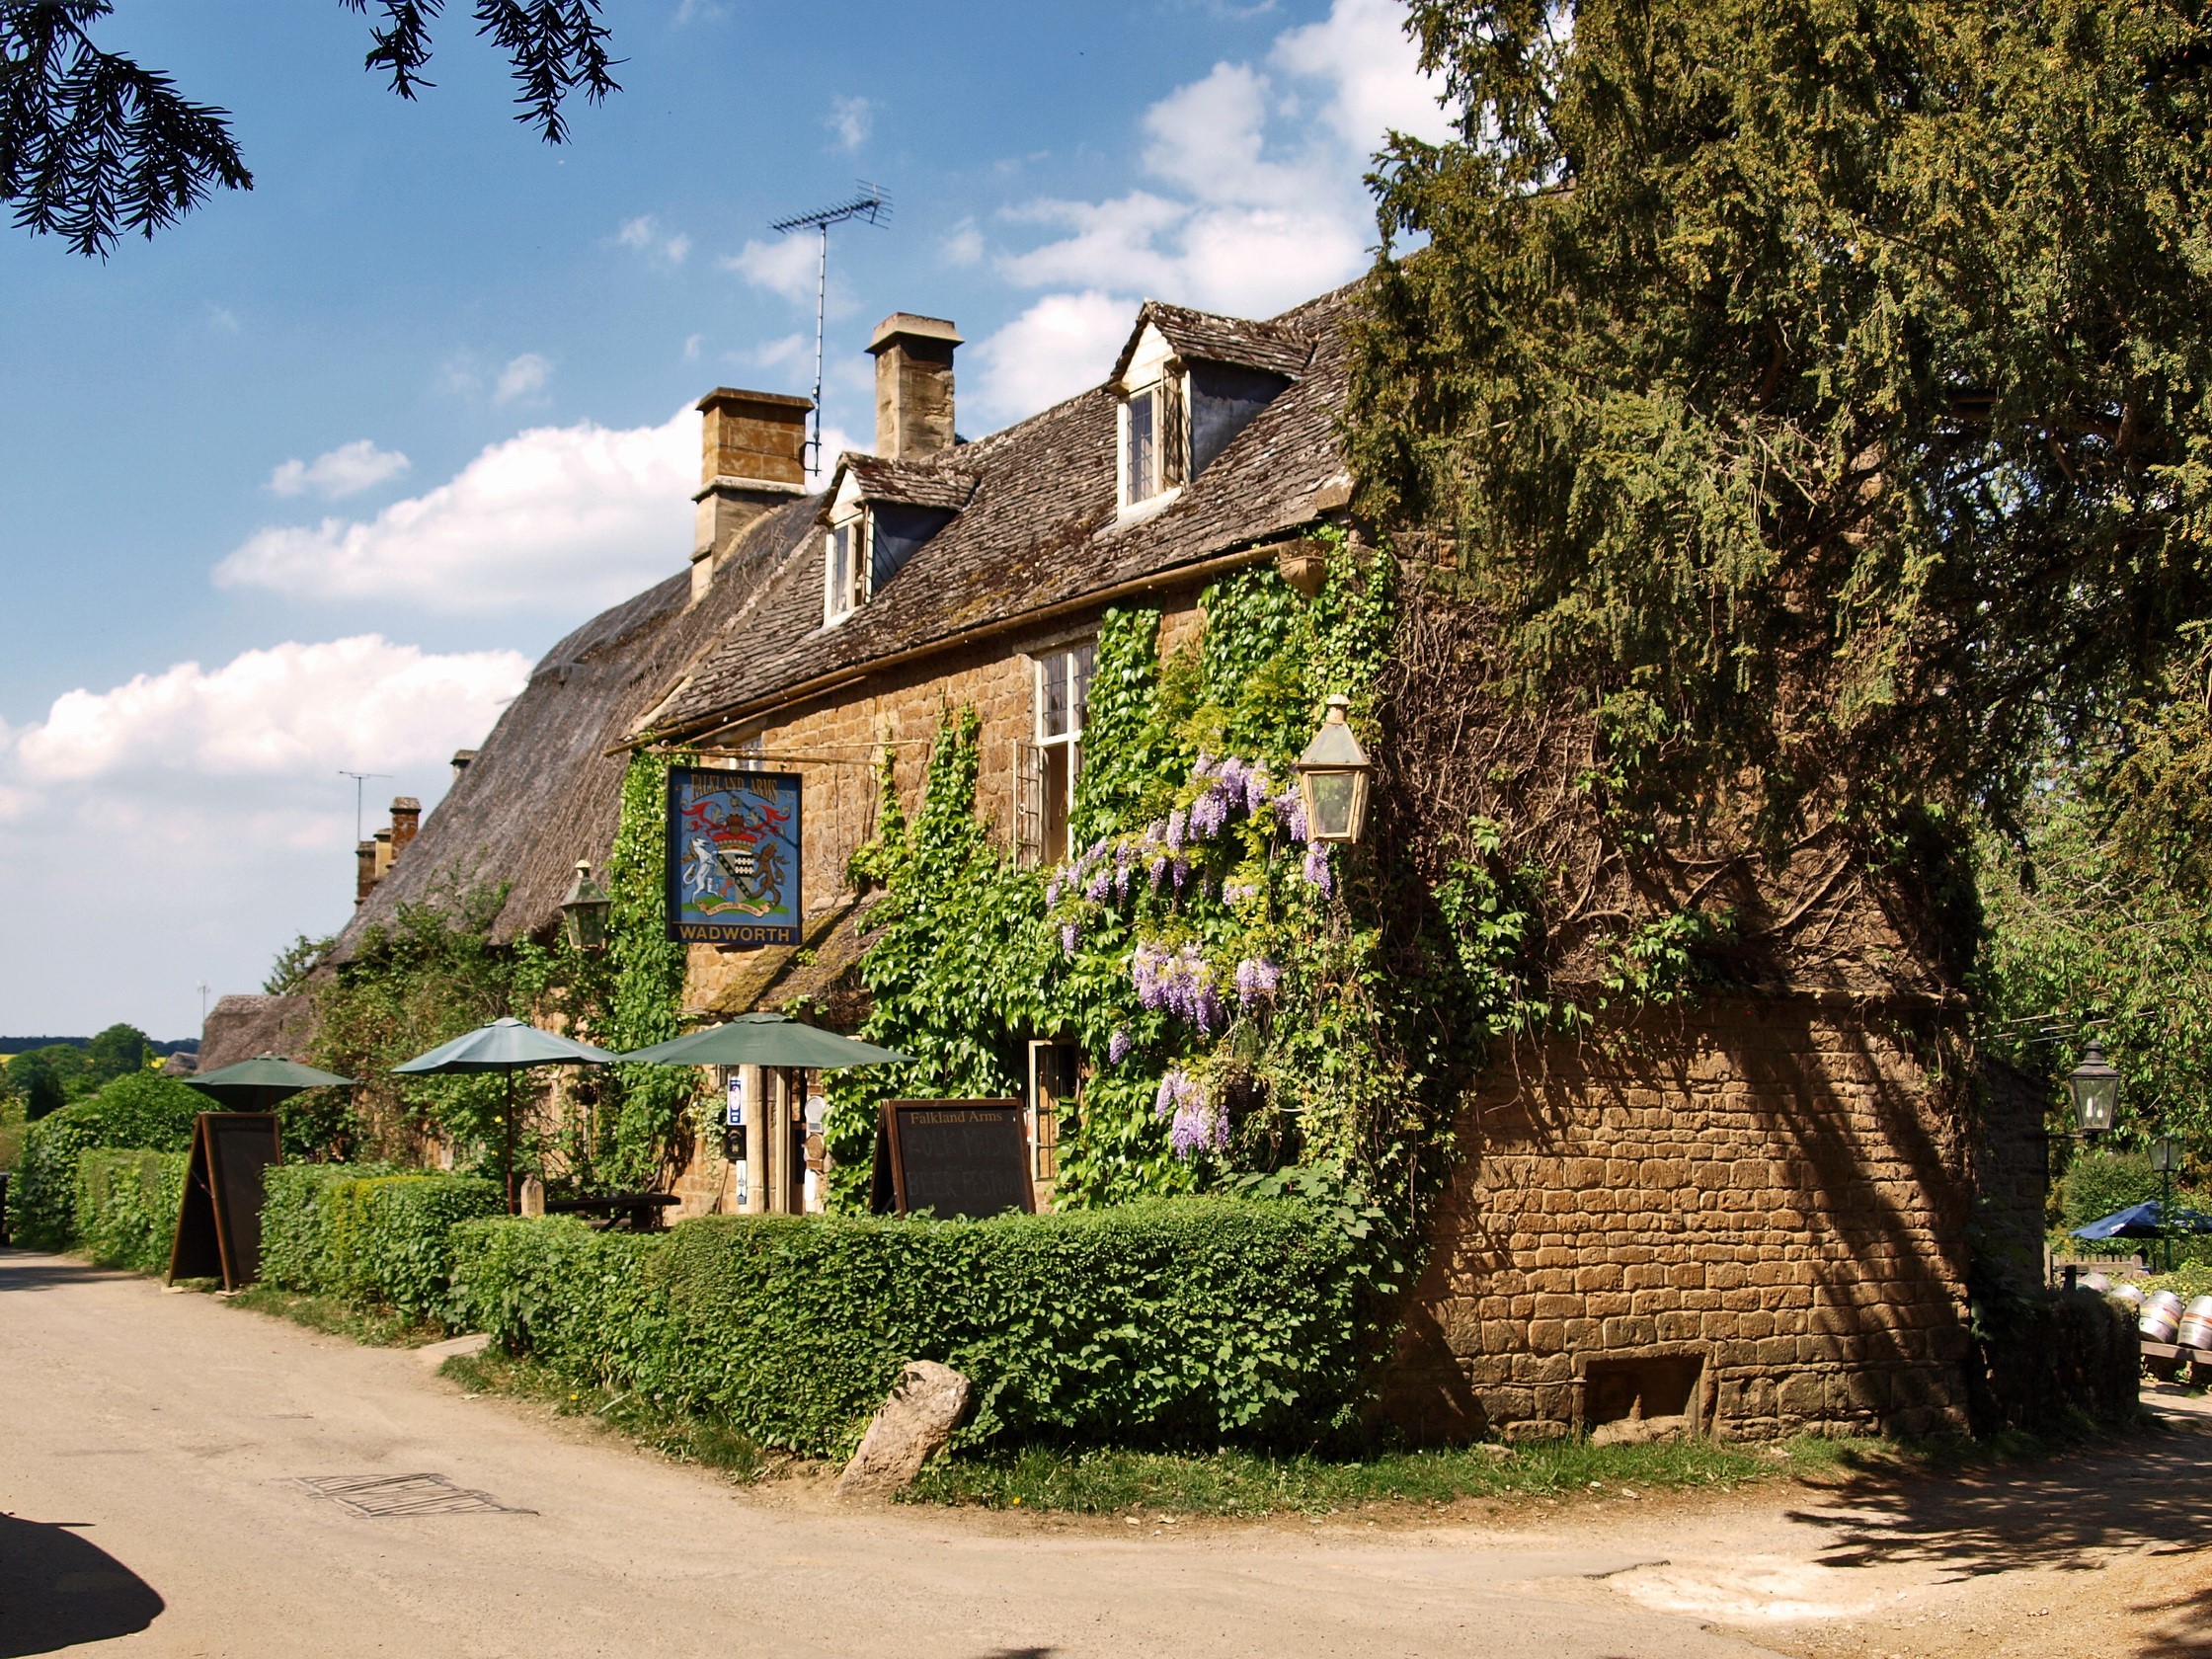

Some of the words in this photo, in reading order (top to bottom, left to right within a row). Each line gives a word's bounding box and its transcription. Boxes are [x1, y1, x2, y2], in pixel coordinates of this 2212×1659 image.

[691, 774, 746, 801] FALKLAND
[750, 778, 777, 805] ARMS
[679, 925, 789, 941] WADWORTH
[910, 1112, 965, 1124] Falkland
[969, 1112, 1003, 1123] Arms
[907, 1170, 958, 1197] BEER
